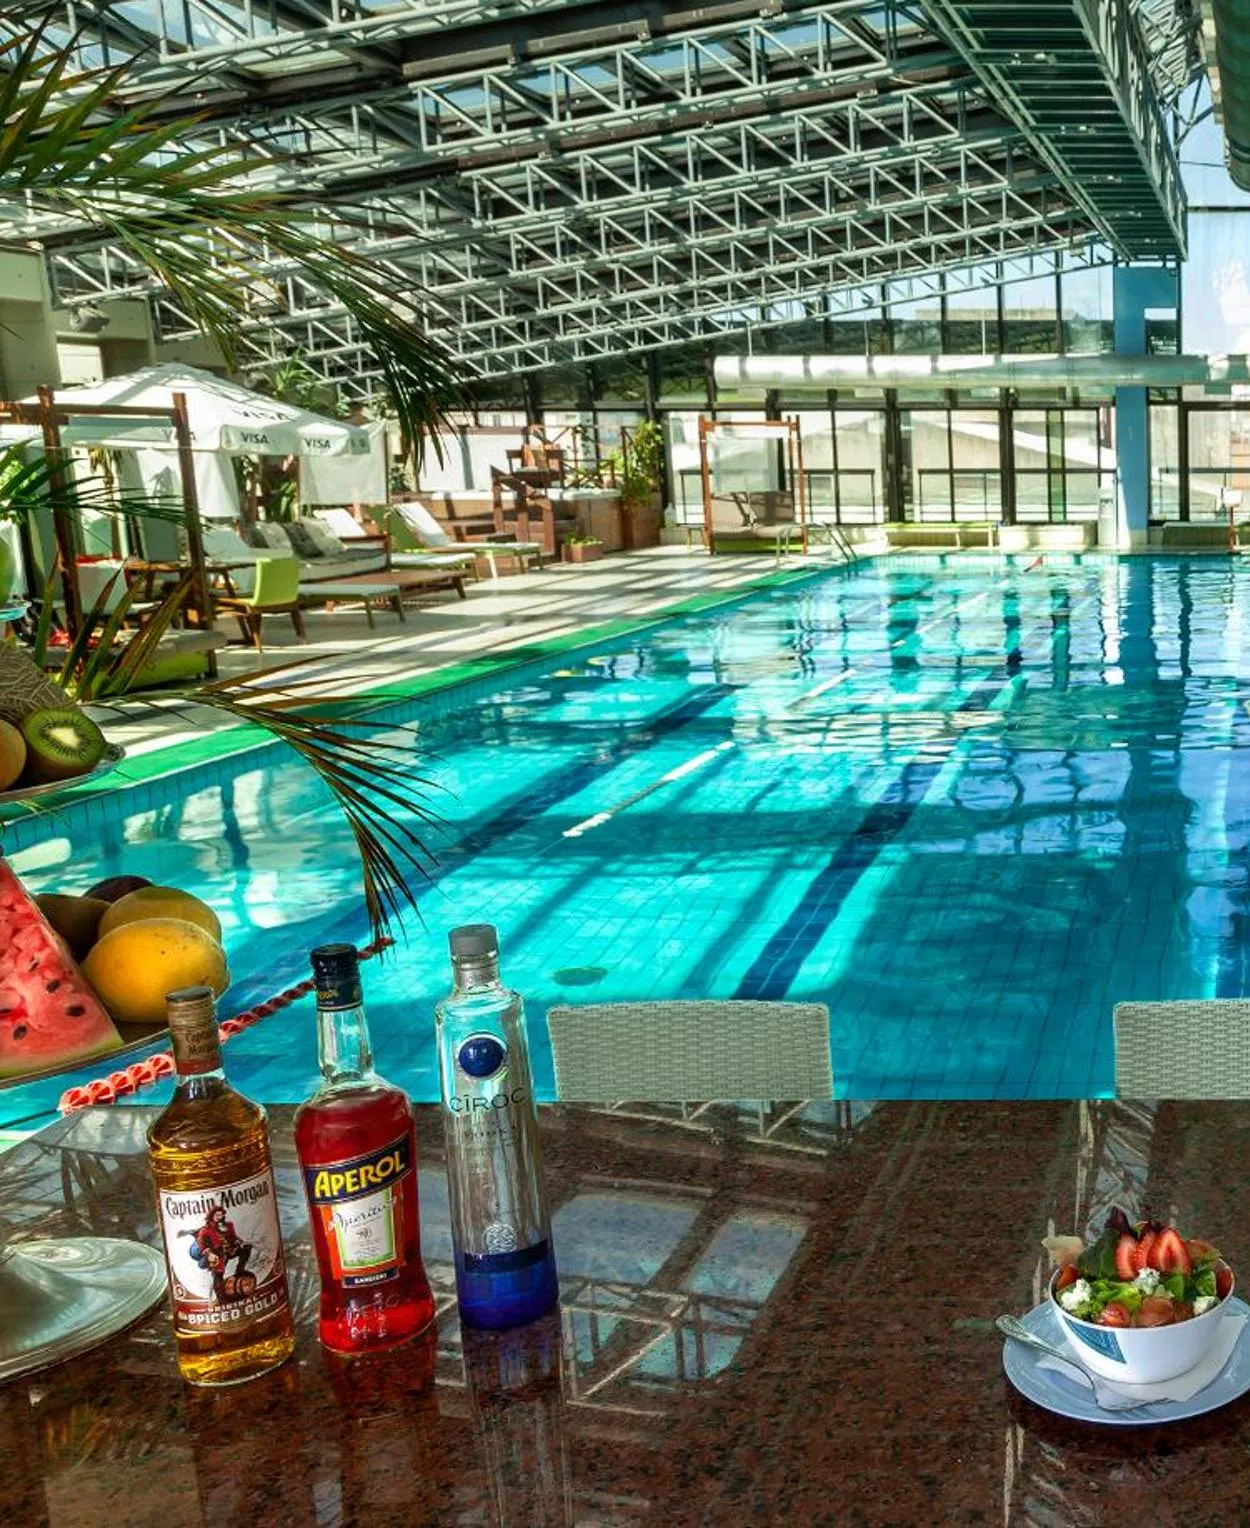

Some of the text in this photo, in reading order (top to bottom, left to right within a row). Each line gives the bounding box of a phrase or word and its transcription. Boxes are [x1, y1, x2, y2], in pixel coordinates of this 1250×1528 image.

[242, 432, 268, 444] VISA
[304, 438, 330, 449] VISA
[314, 1151, 404, 1198] APEROL
[165, 1180, 269, 1220] Captain Morgan
[188, 1292, 278, 1325] SPICED GOLD
